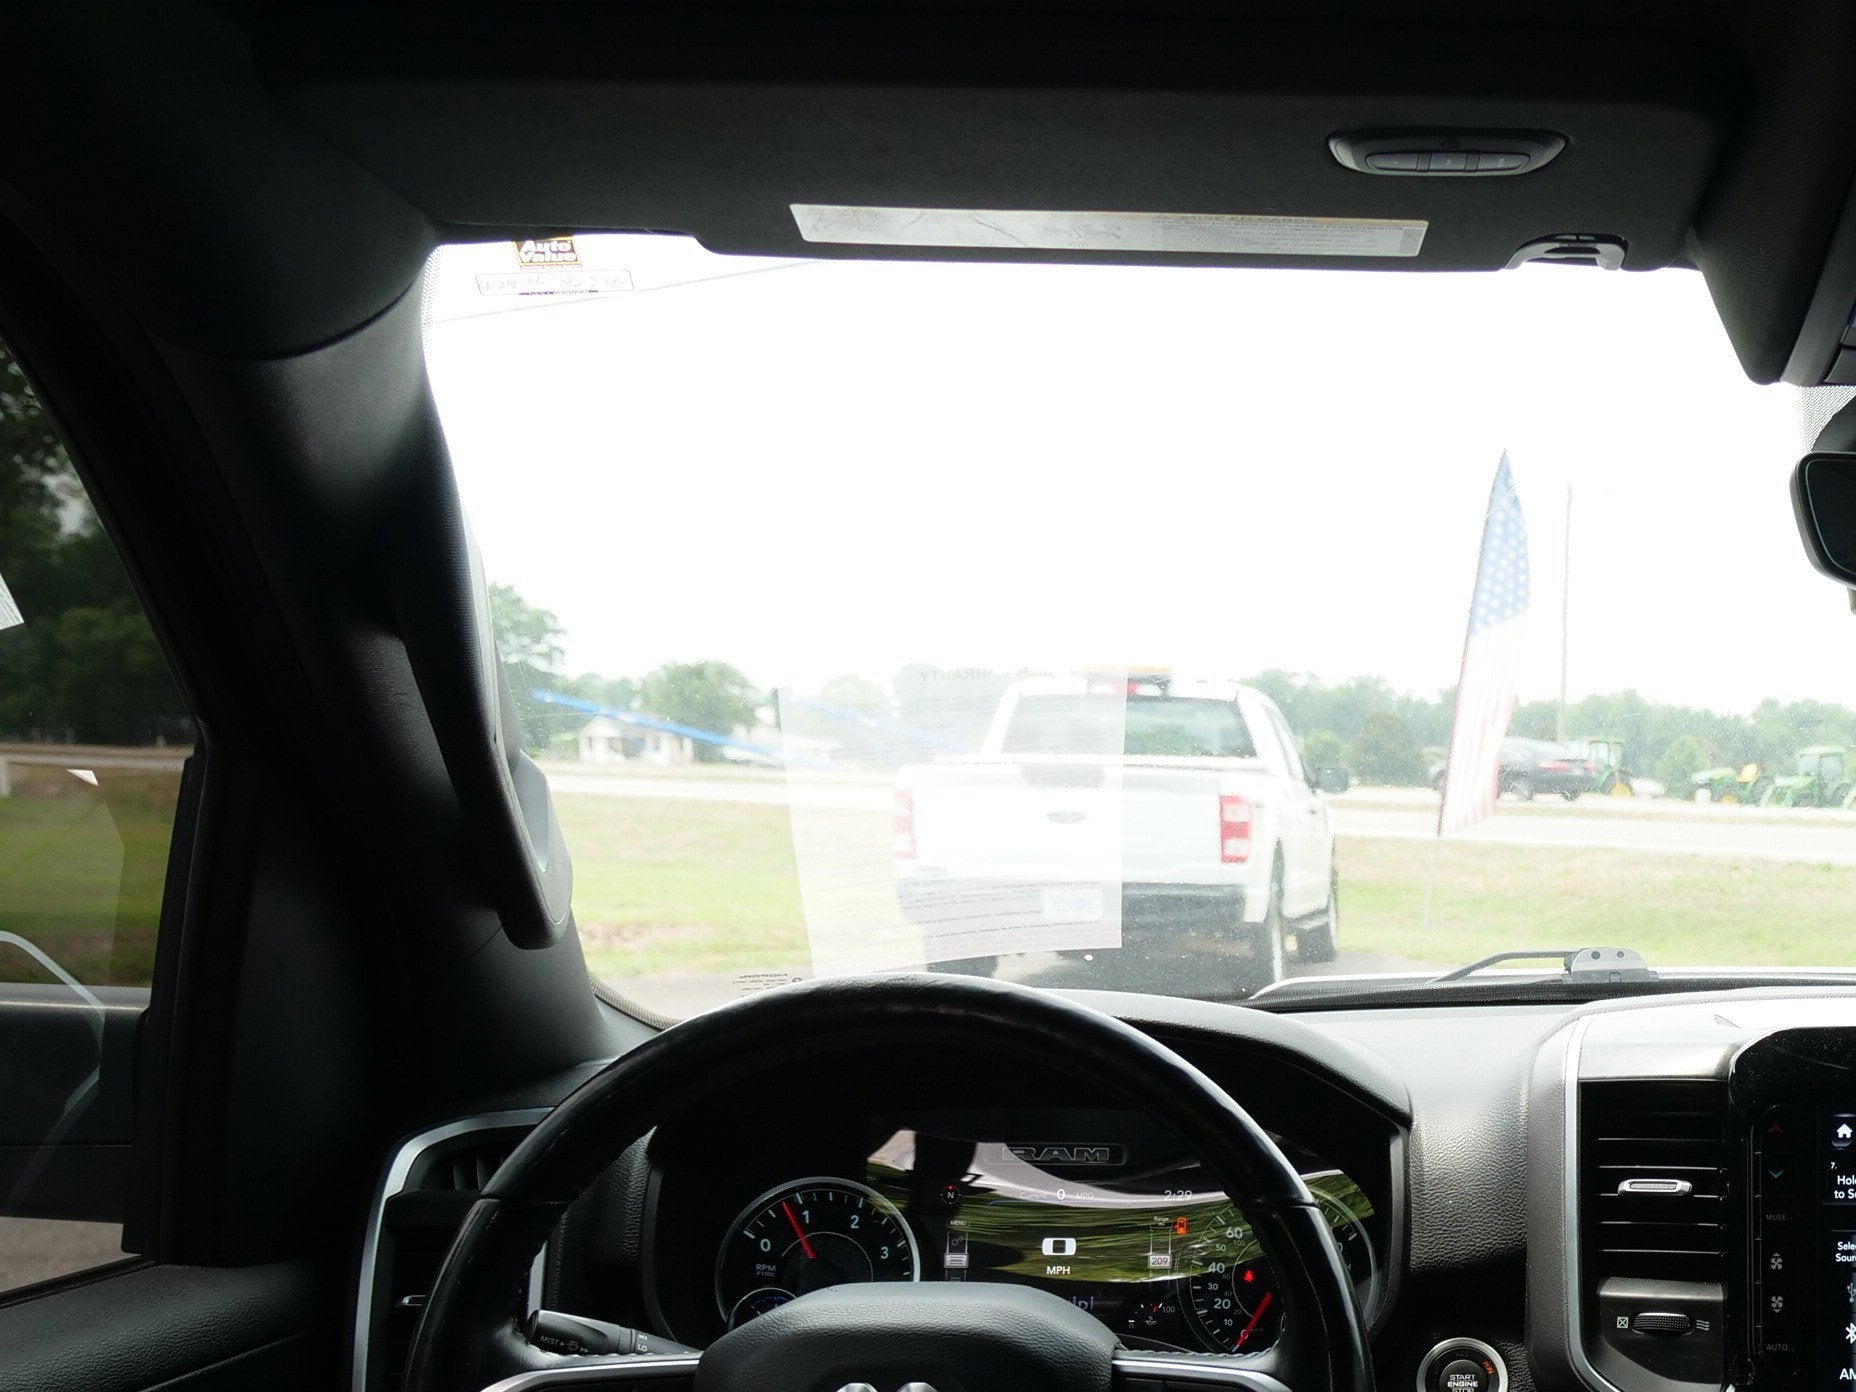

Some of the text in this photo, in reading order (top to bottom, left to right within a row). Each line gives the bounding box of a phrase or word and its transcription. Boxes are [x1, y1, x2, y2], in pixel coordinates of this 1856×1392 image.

[520, 239, 573, 252] Auto
[518, 249, 578, 263] Value
[1002, 1147, 1110, 1162] RAM
[1056, 1188, 1066, 1201] 0
[1163, 1189, 1193, 1202] 2:29
[1833, 1189, 1845, 1199] to
[801, 1210, 811, 1224] 1
[849, 1214, 860, 1229] 2
[1765, 1213, 1788, 1222] MODE
[1226, 1227, 1243, 1239] 60
[759, 1238, 772, 1252] 0
[1215, 1243, 1227, 1252] 50
[880, 1246, 890, 1260] 3
[1151, 1256, 1169, 1266] 209
[755, 1263, 777, 1272] RPM
[1045, 1265, 1071, 1276] MPH
[1207, 1262, 1226, 1275] 40
[1207, 1282, 1219, 1291] 30
[1213, 1298, 1231, 1310] 20
[1223, 1318, 1233, 1327] 10
[1765, 1343, 1788, 1351] AUTO
